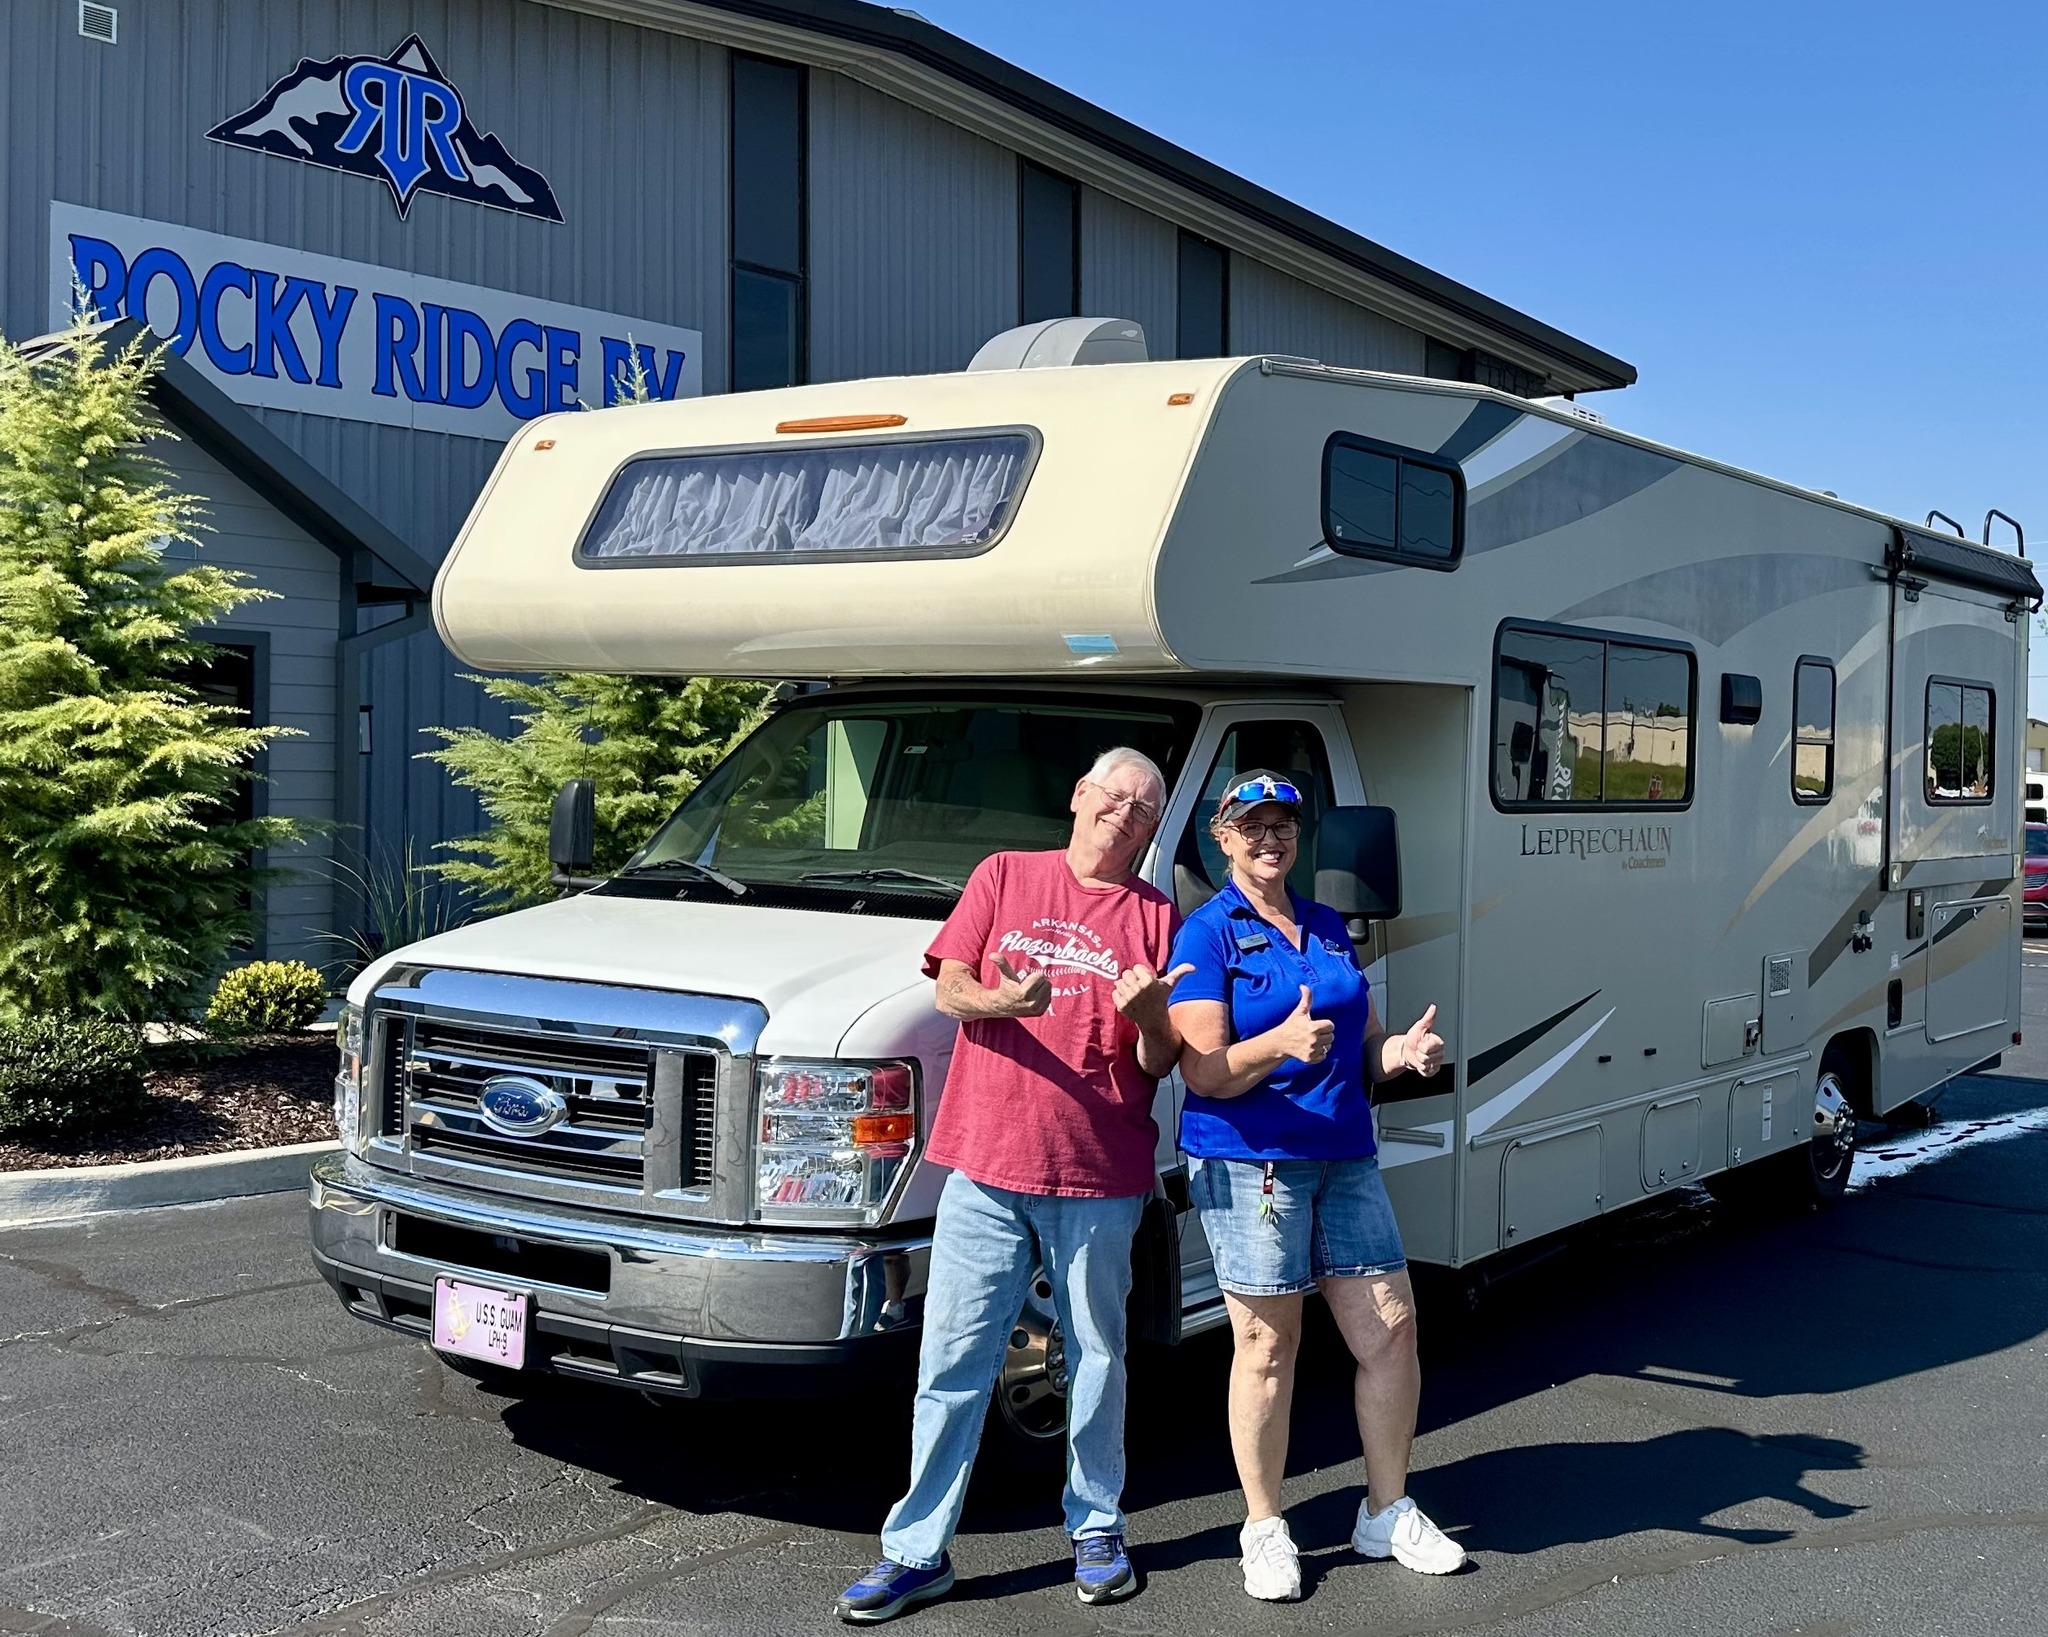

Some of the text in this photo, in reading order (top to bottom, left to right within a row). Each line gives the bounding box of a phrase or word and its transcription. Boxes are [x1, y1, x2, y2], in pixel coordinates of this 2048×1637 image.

[68, 233, 685, 420] ROCKY RIDGE RV
[1032, 917, 1102, 944] ARKANSAS
[999, 930, 1119, 974] Razorbacks
[1016, 968, 1091, 998] BBALL
[500, 1307, 522, 1333] GUAM
